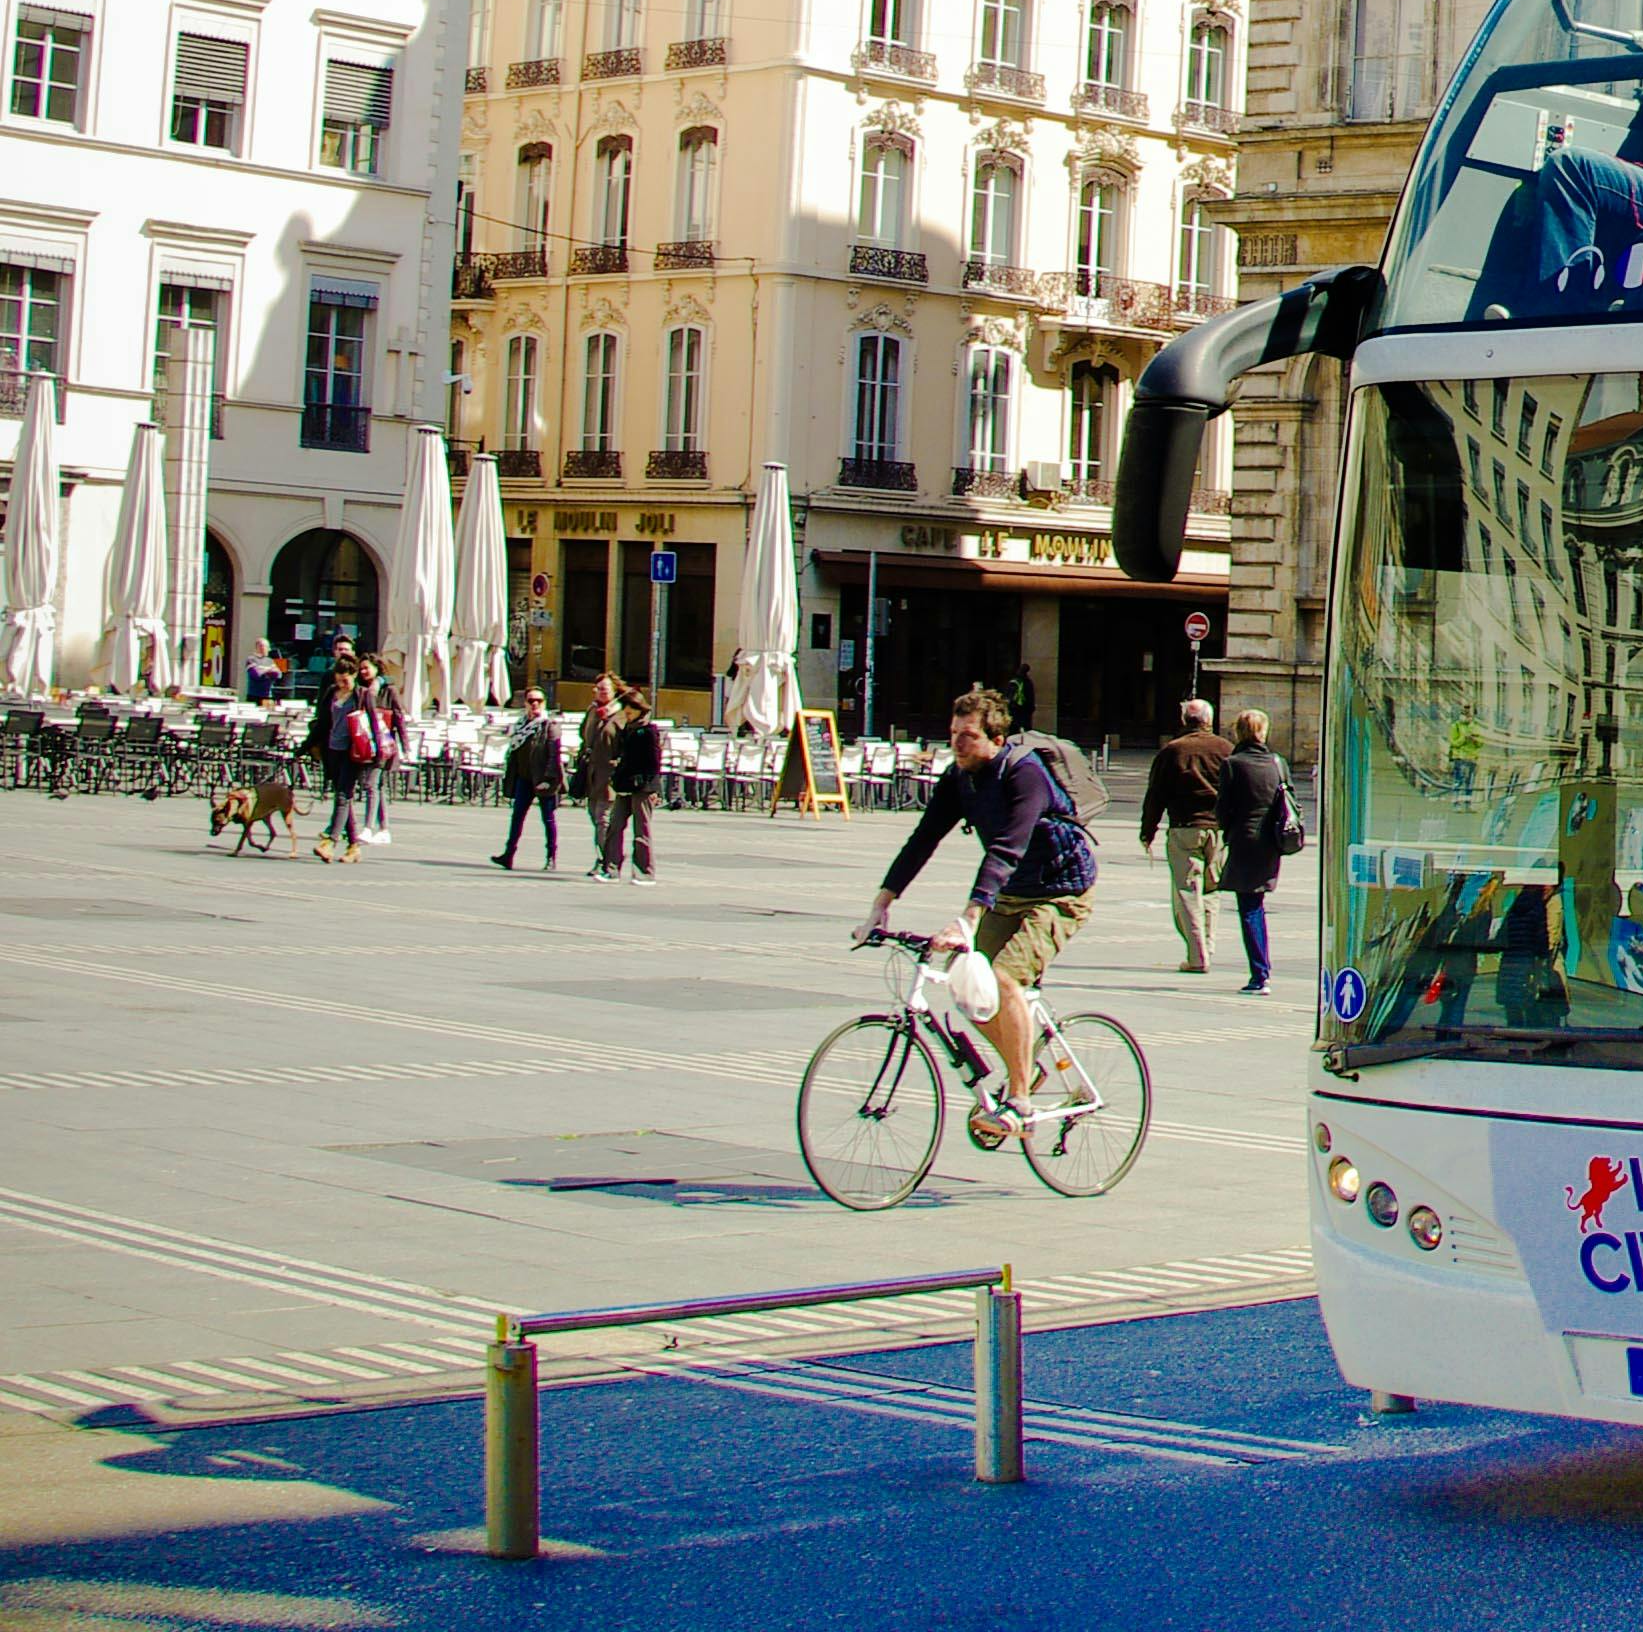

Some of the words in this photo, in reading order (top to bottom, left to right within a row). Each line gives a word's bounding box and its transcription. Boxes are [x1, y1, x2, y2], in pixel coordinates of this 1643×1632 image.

[517, 509, 539, 534] LE
[553, 510, 619, 533] MOULIN
[635, 512, 676, 535] JOLI
[981, 529, 1010, 555] LE
[1034, 533, 1114, 560] MOULIN
